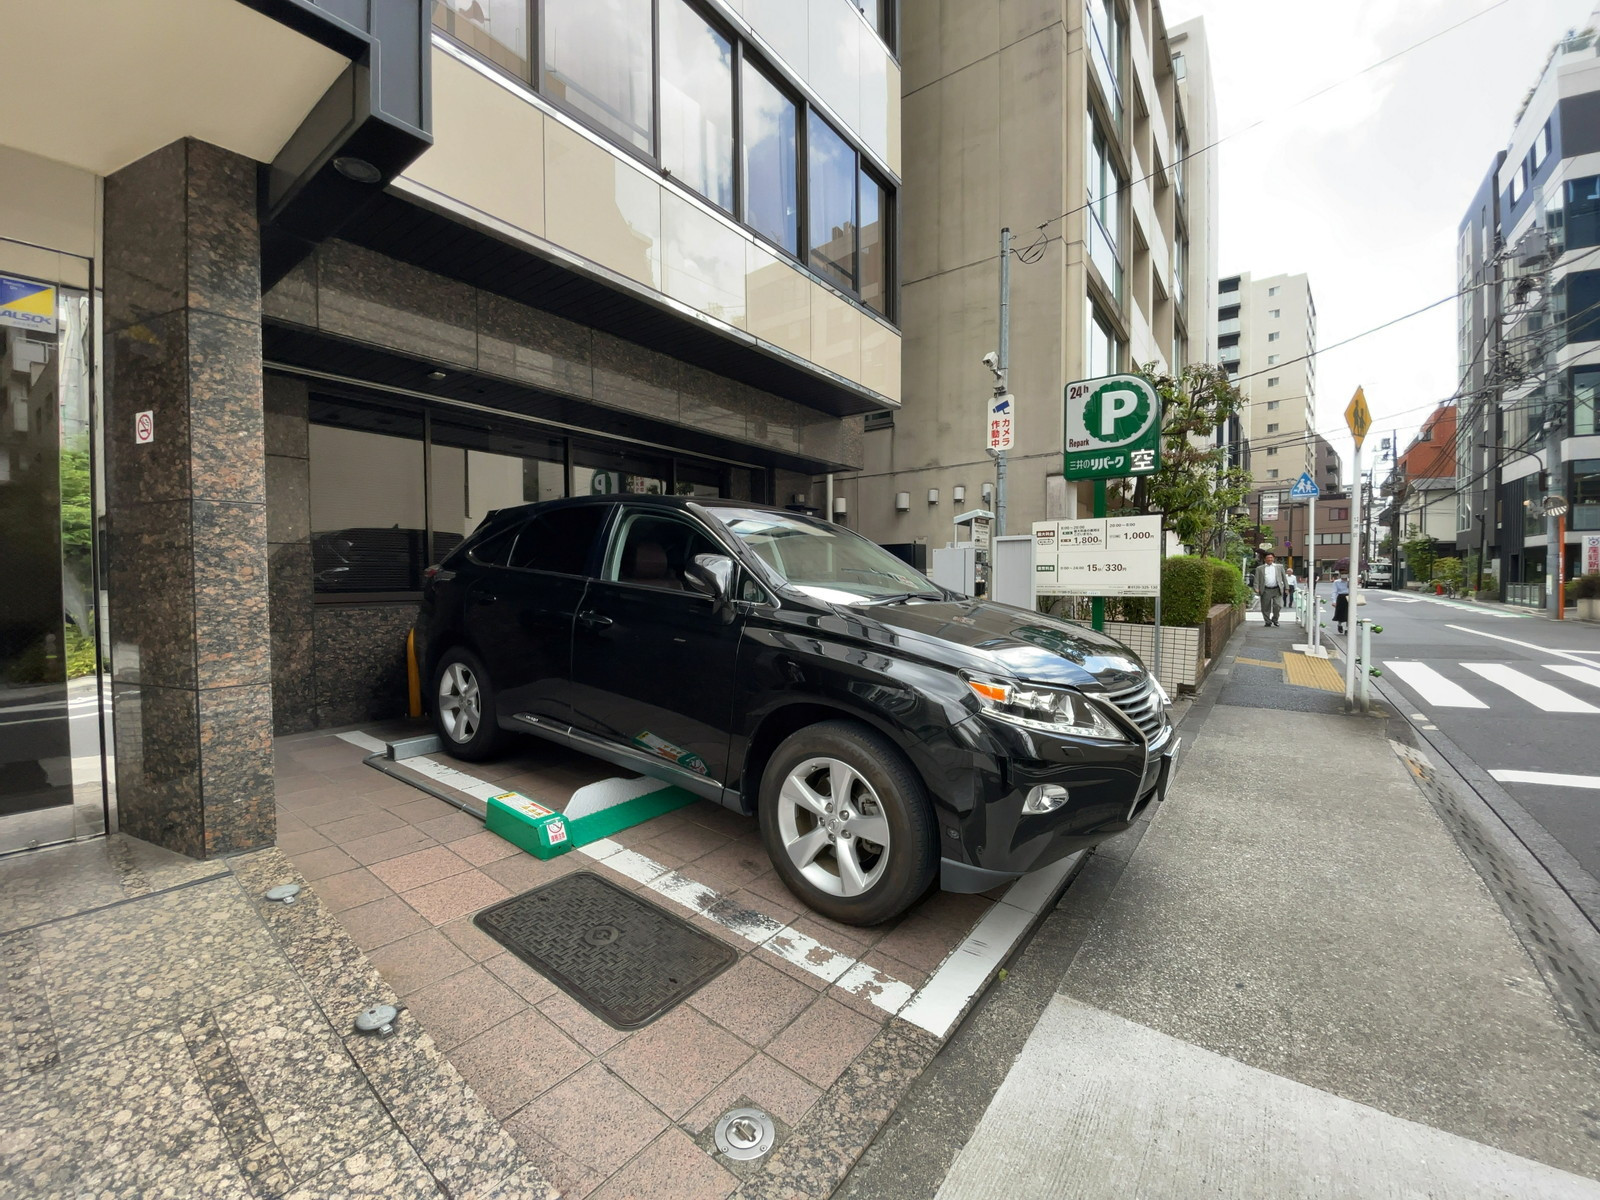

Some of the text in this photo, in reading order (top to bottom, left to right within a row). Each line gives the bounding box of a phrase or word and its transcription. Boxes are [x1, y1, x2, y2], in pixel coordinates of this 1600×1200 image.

[0, 310, 51, 325] ALSOK
[1070, 385, 1089, 400] 24h
[1101, 390, 1138, 435] P
[991, 420, 1000, 447] 作動中
[1002, 419, 1010, 446] カメラ
[1069, 439, 1090, 448] Repark
[1070, 456, 1124, 471] 三井のリパーク
[1130, 449, 1155, 471] 空
